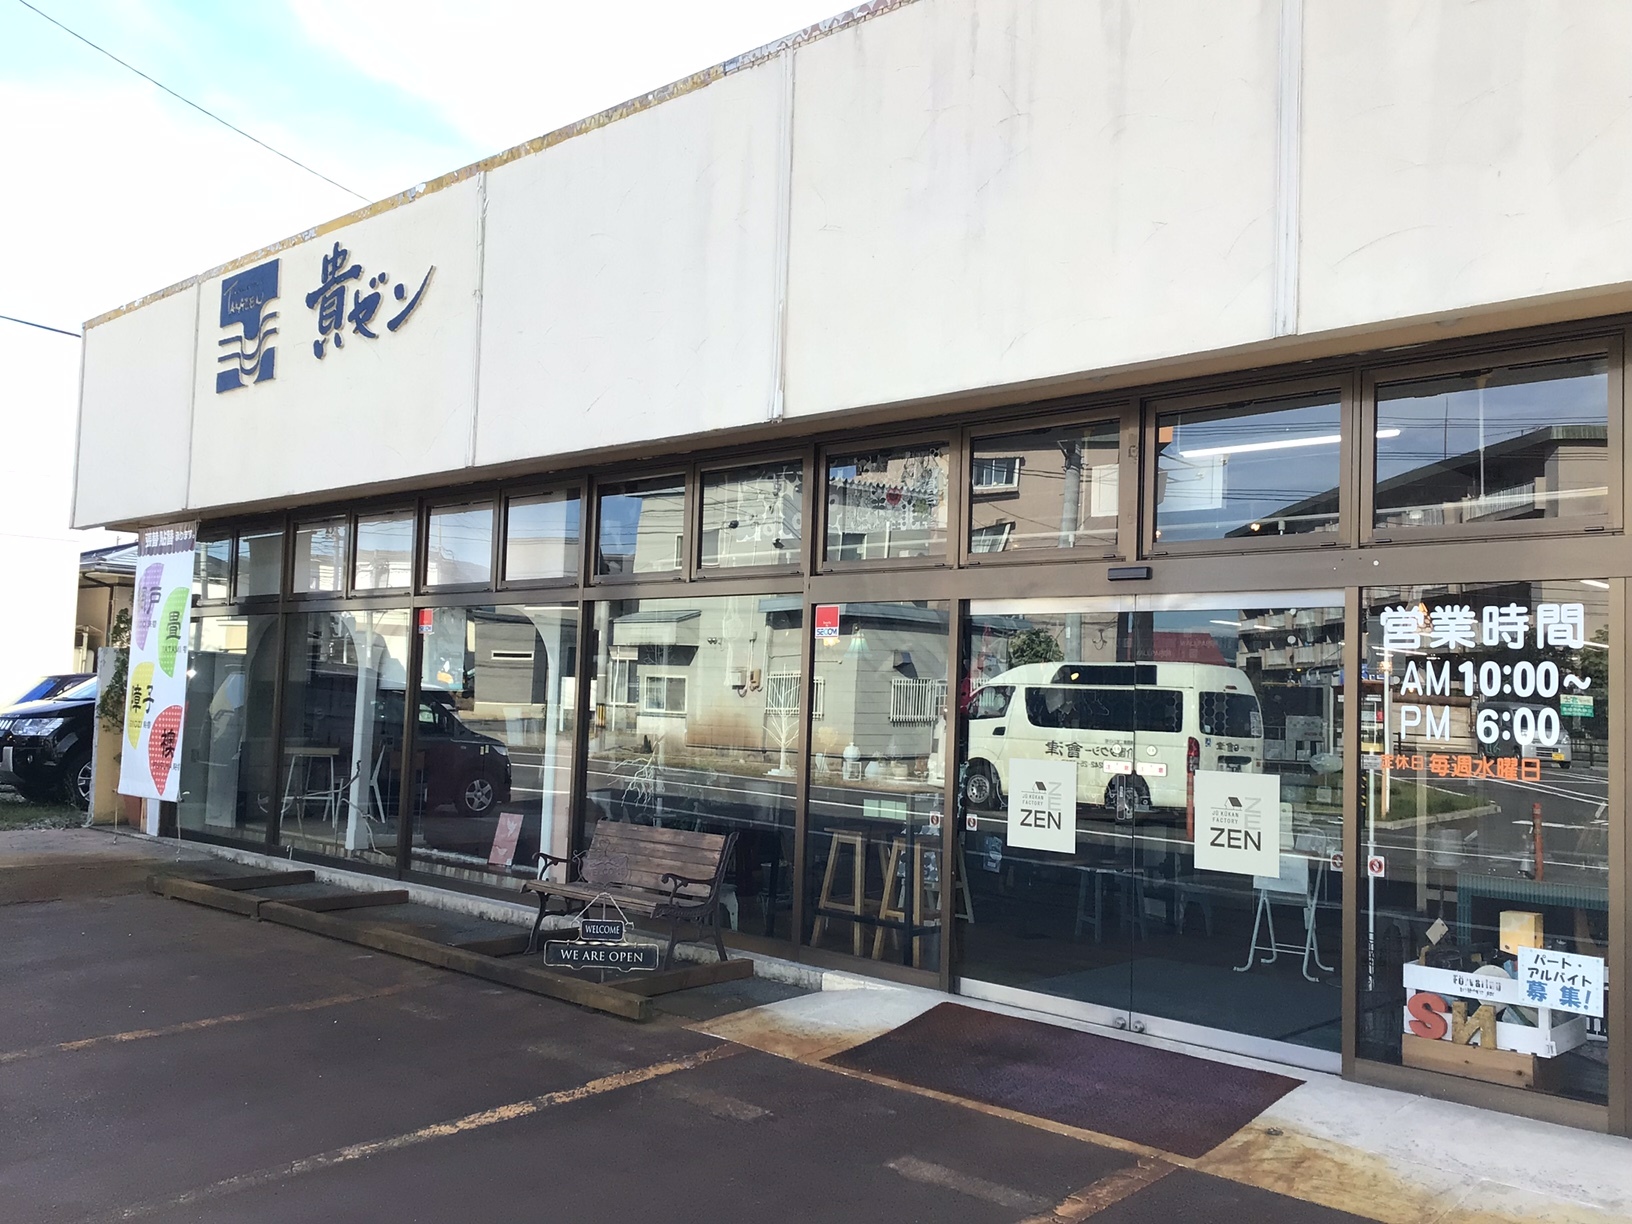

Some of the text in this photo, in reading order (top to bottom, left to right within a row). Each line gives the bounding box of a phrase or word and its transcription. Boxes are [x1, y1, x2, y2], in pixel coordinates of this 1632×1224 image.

[305, 241, 436, 360] 貴ゼン
[1380, 602, 1585, 650] 営業時間
[1400, 660, 1450, 697] AM
[1400, 705, 1450, 742] PM
[1476, 706, 1560, 746] 6:00
[1380, 754, 1424, 771] 定休日
[1429, 753, 1541, 782] 毎週水曜日
[1020, 808, 1061, 830] ZEN
[1212, 817, 1238, 825] FACTORY
[1210, 827, 1261, 851] ZEN
[585, 924, 620, 935] WELCOME
[560, 949, 643, 962] WE ARE OPEN
[1527, 966, 1593, 987] アルバイト
